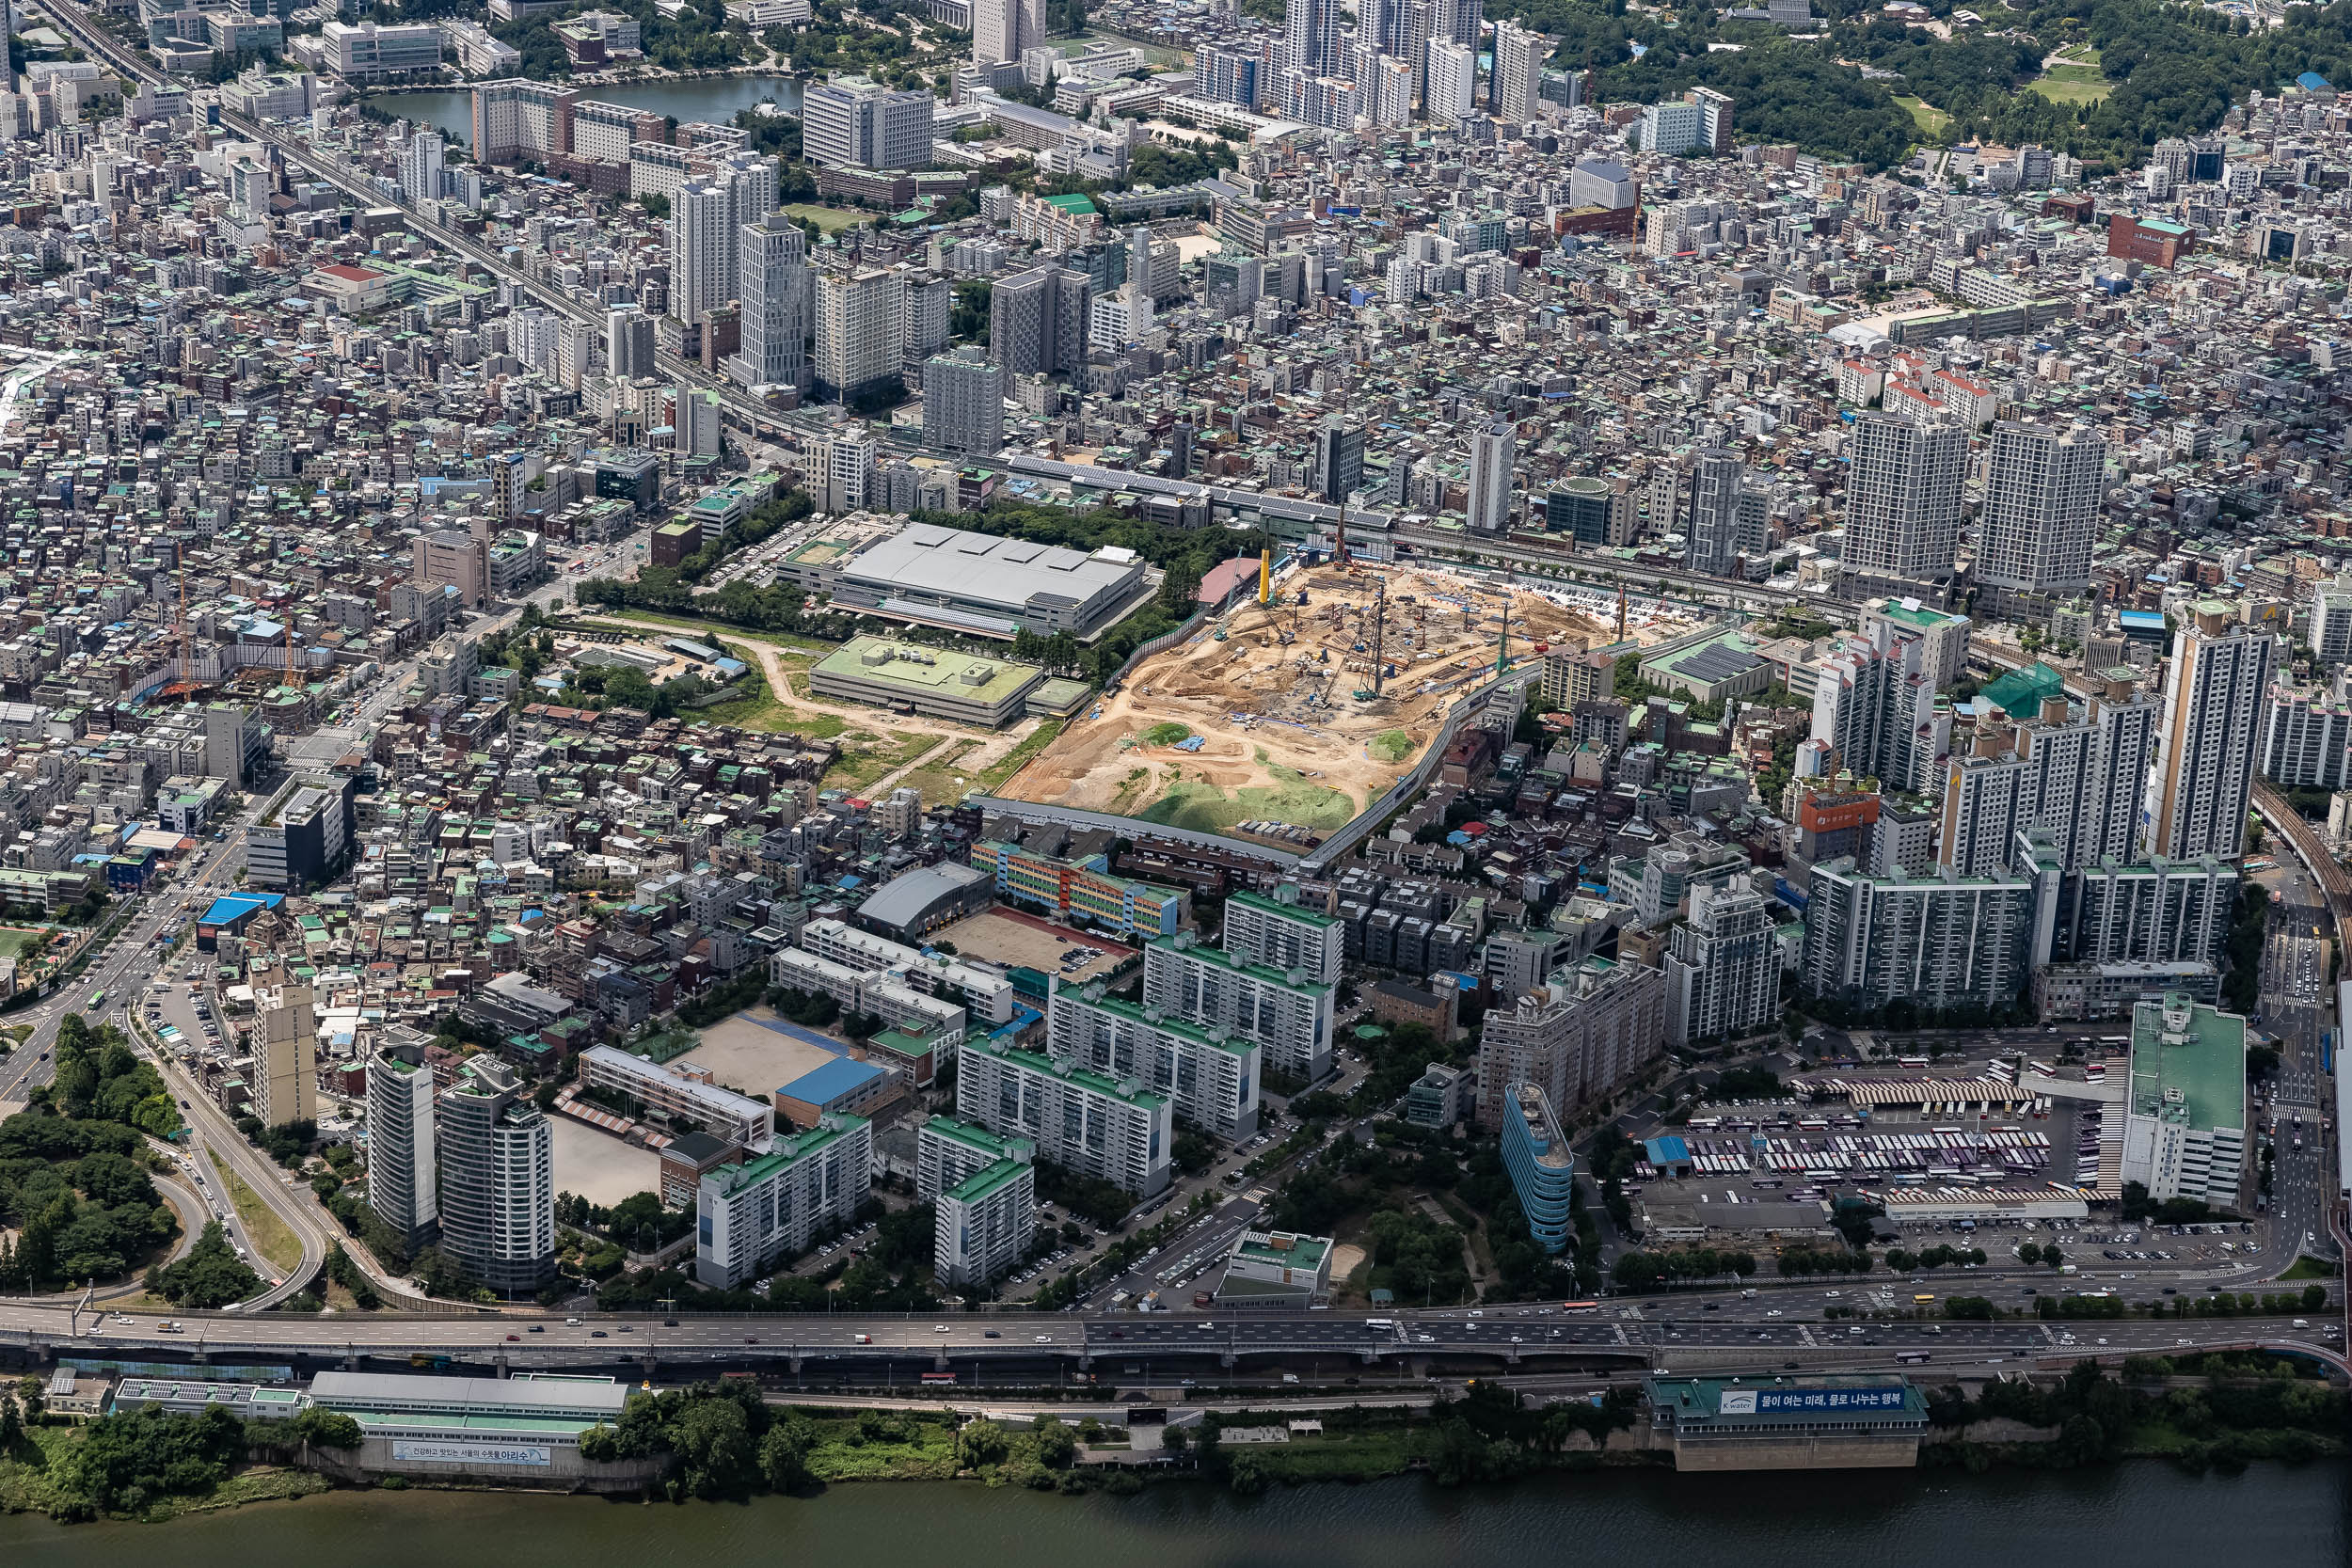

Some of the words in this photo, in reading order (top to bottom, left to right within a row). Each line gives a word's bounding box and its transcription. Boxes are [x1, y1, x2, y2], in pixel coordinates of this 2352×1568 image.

[1761, 1395, 1781, 1407] 물이
[1784, 1394, 1803, 1407] 여는
[1805, 1394, 1826, 1407] 미래,
[1829, 1394, 1849, 1406] 물로
[1851, 1393, 1880, 1405] 나누는
[1882, 1392, 1900, 1405] 행복
[413, 1448, 437, 1456] 건강하고
[439, 1448, 458, 1457] 맛있는
[461, 1449, 480, 1457] 서울의
[481, 1449, 501, 1459] 수돗물
[501, 1450, 529, 1461] 아리수
